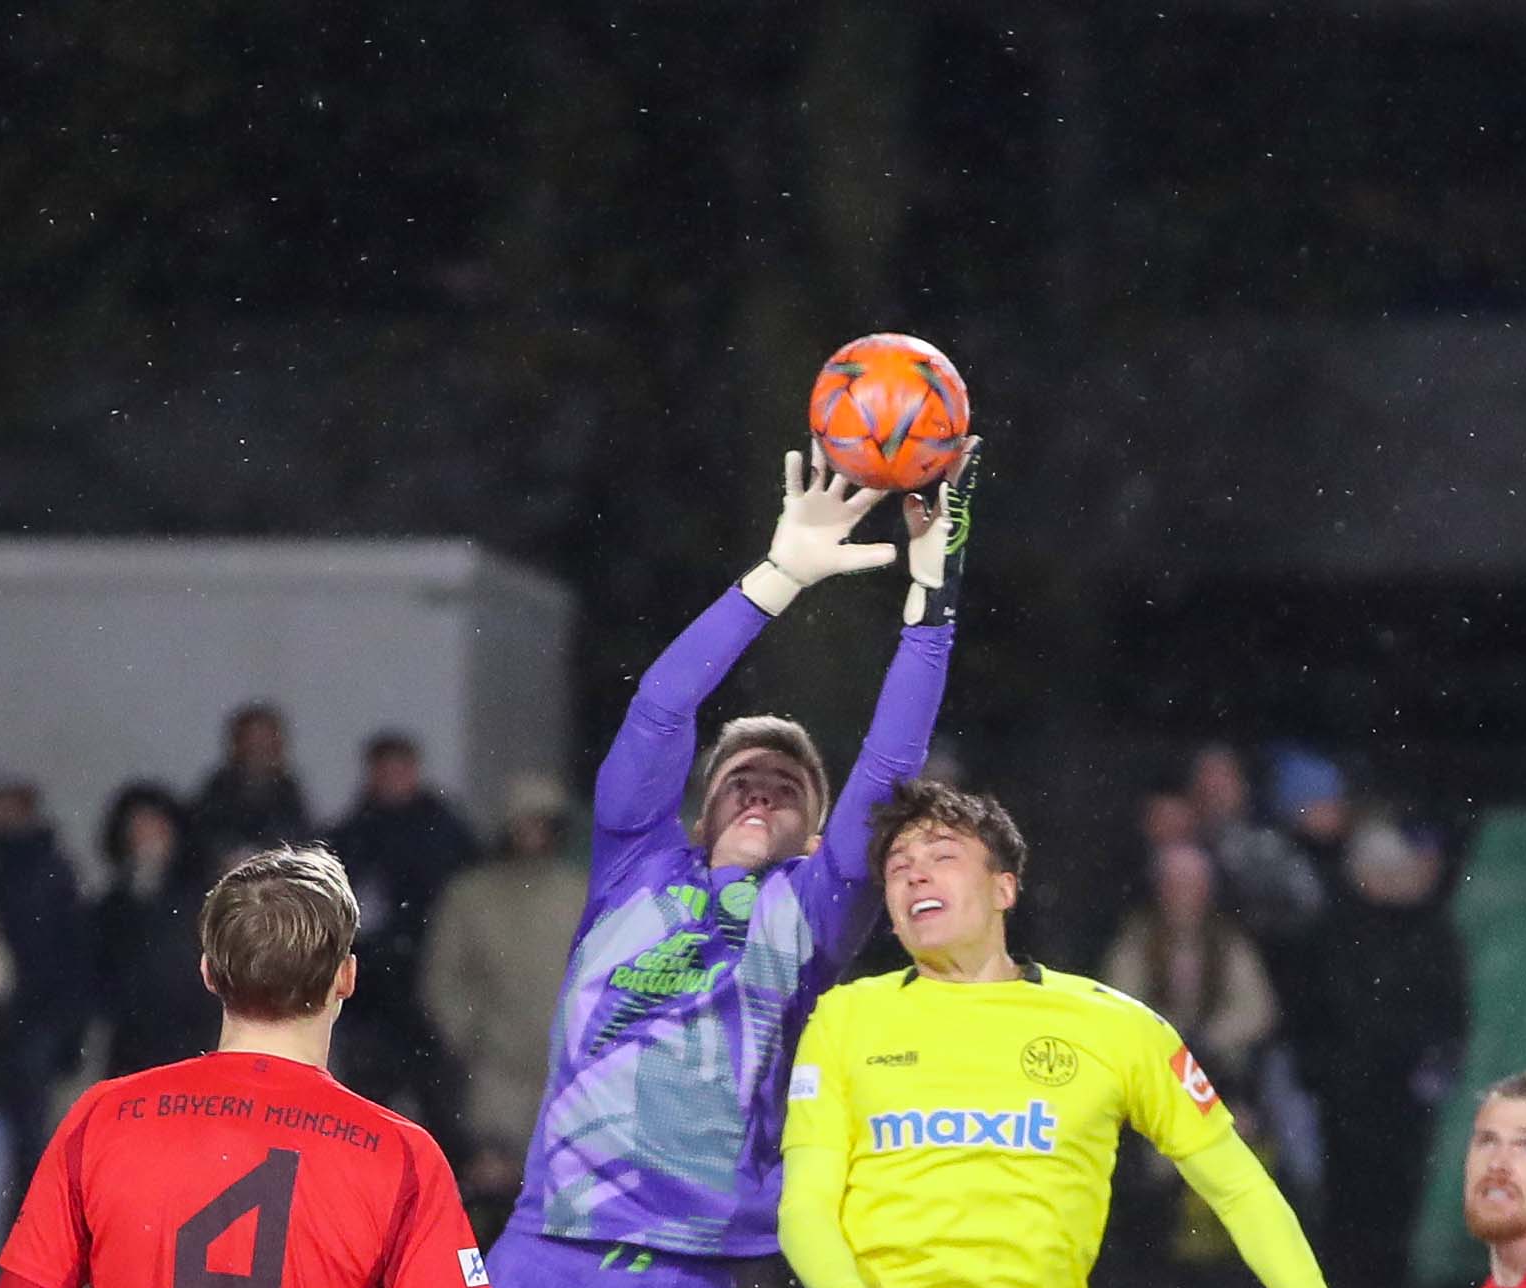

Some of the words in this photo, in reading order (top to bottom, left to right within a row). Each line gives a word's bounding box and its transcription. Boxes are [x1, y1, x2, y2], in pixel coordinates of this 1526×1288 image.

[117, 1097, 146, 1121] FC
[157, 1094, 254, 1119] BAYERN
[264, 1103, 381, 1153] MÜNCHEN
[868, 1101, 1056, 1152] maxit
